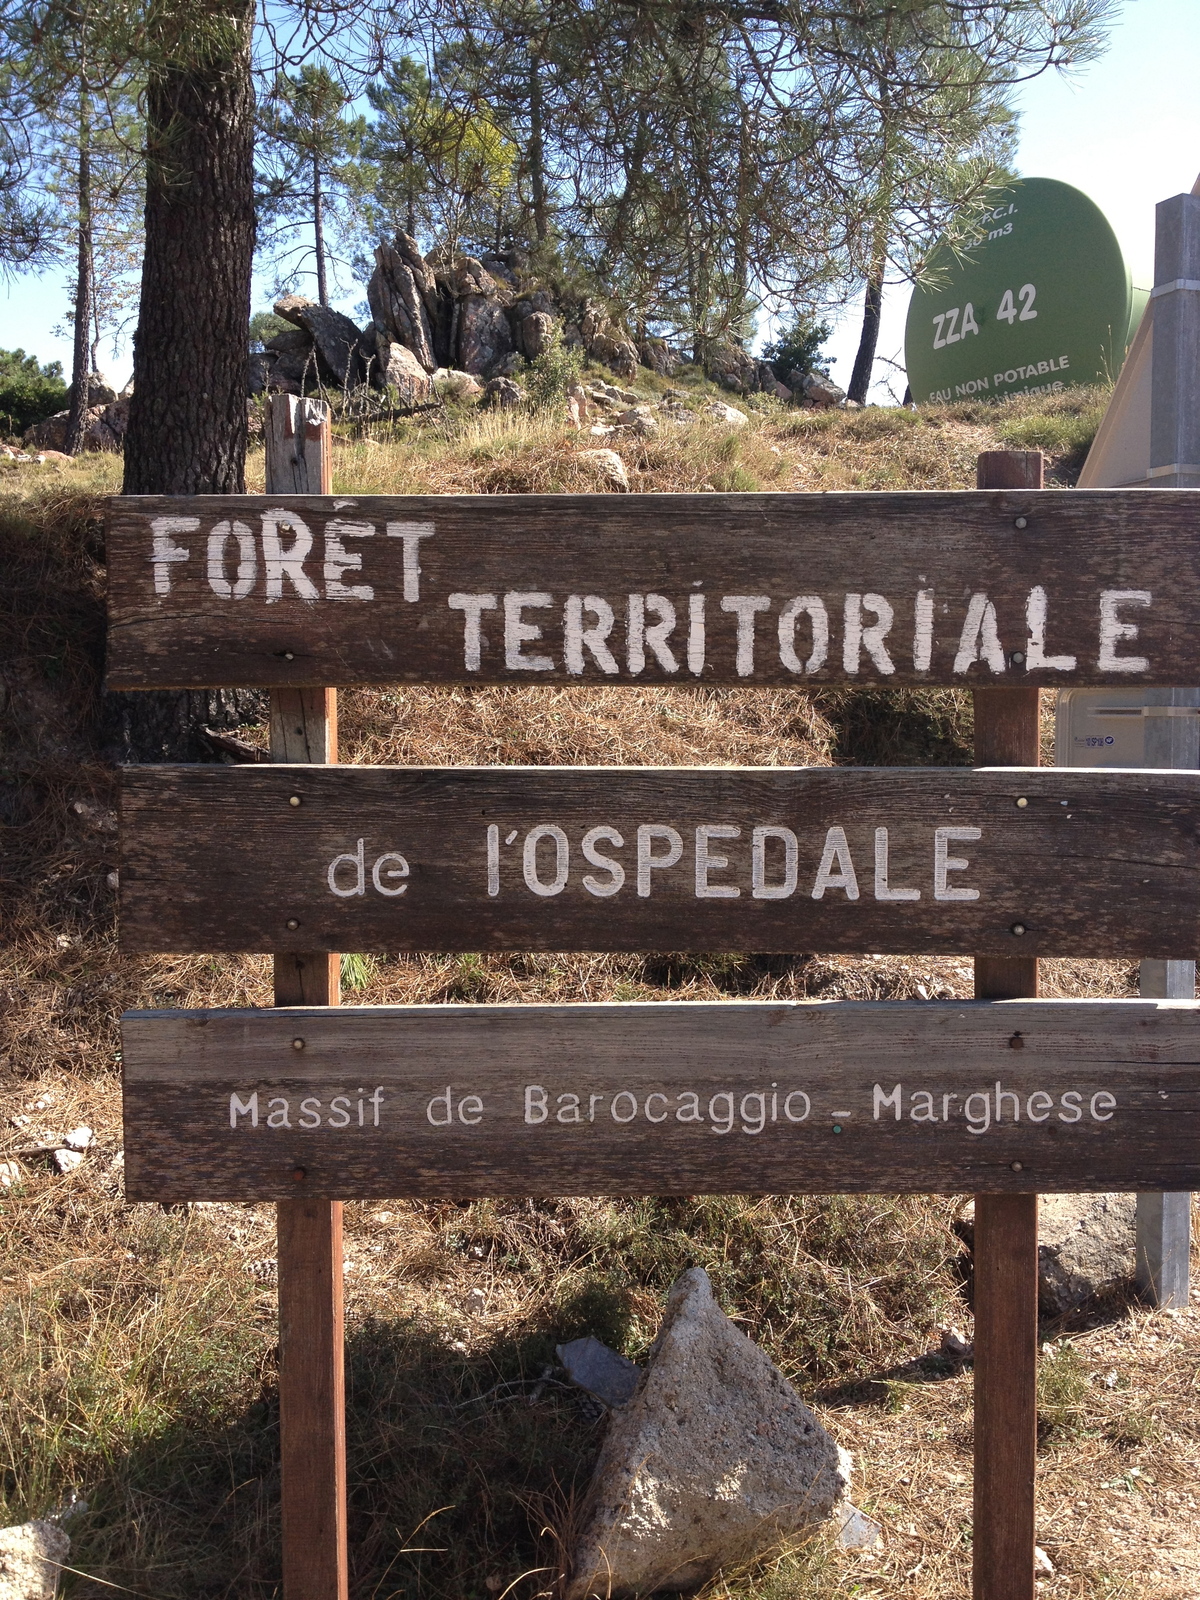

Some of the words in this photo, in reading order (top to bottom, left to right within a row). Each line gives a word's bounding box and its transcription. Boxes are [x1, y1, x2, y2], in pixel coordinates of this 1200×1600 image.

[988, 222, 1013, 241] m3
[932, 302, 979, 350] ZZA
[996, 283, 1038, 325] 42
[929, 387, 951, 403] EAU
[955, 376, 989, 397] NON
[993, 355, 1070, 387] POTABLE
[327, 838, 410, 897] de
[229, 1086, 384, 1128] Massif
[426, 1086, 484, 1126] de
[523, 1082, 812, 1135] Barocaggio
[872, 1081, 1117, 1135] Marghese
